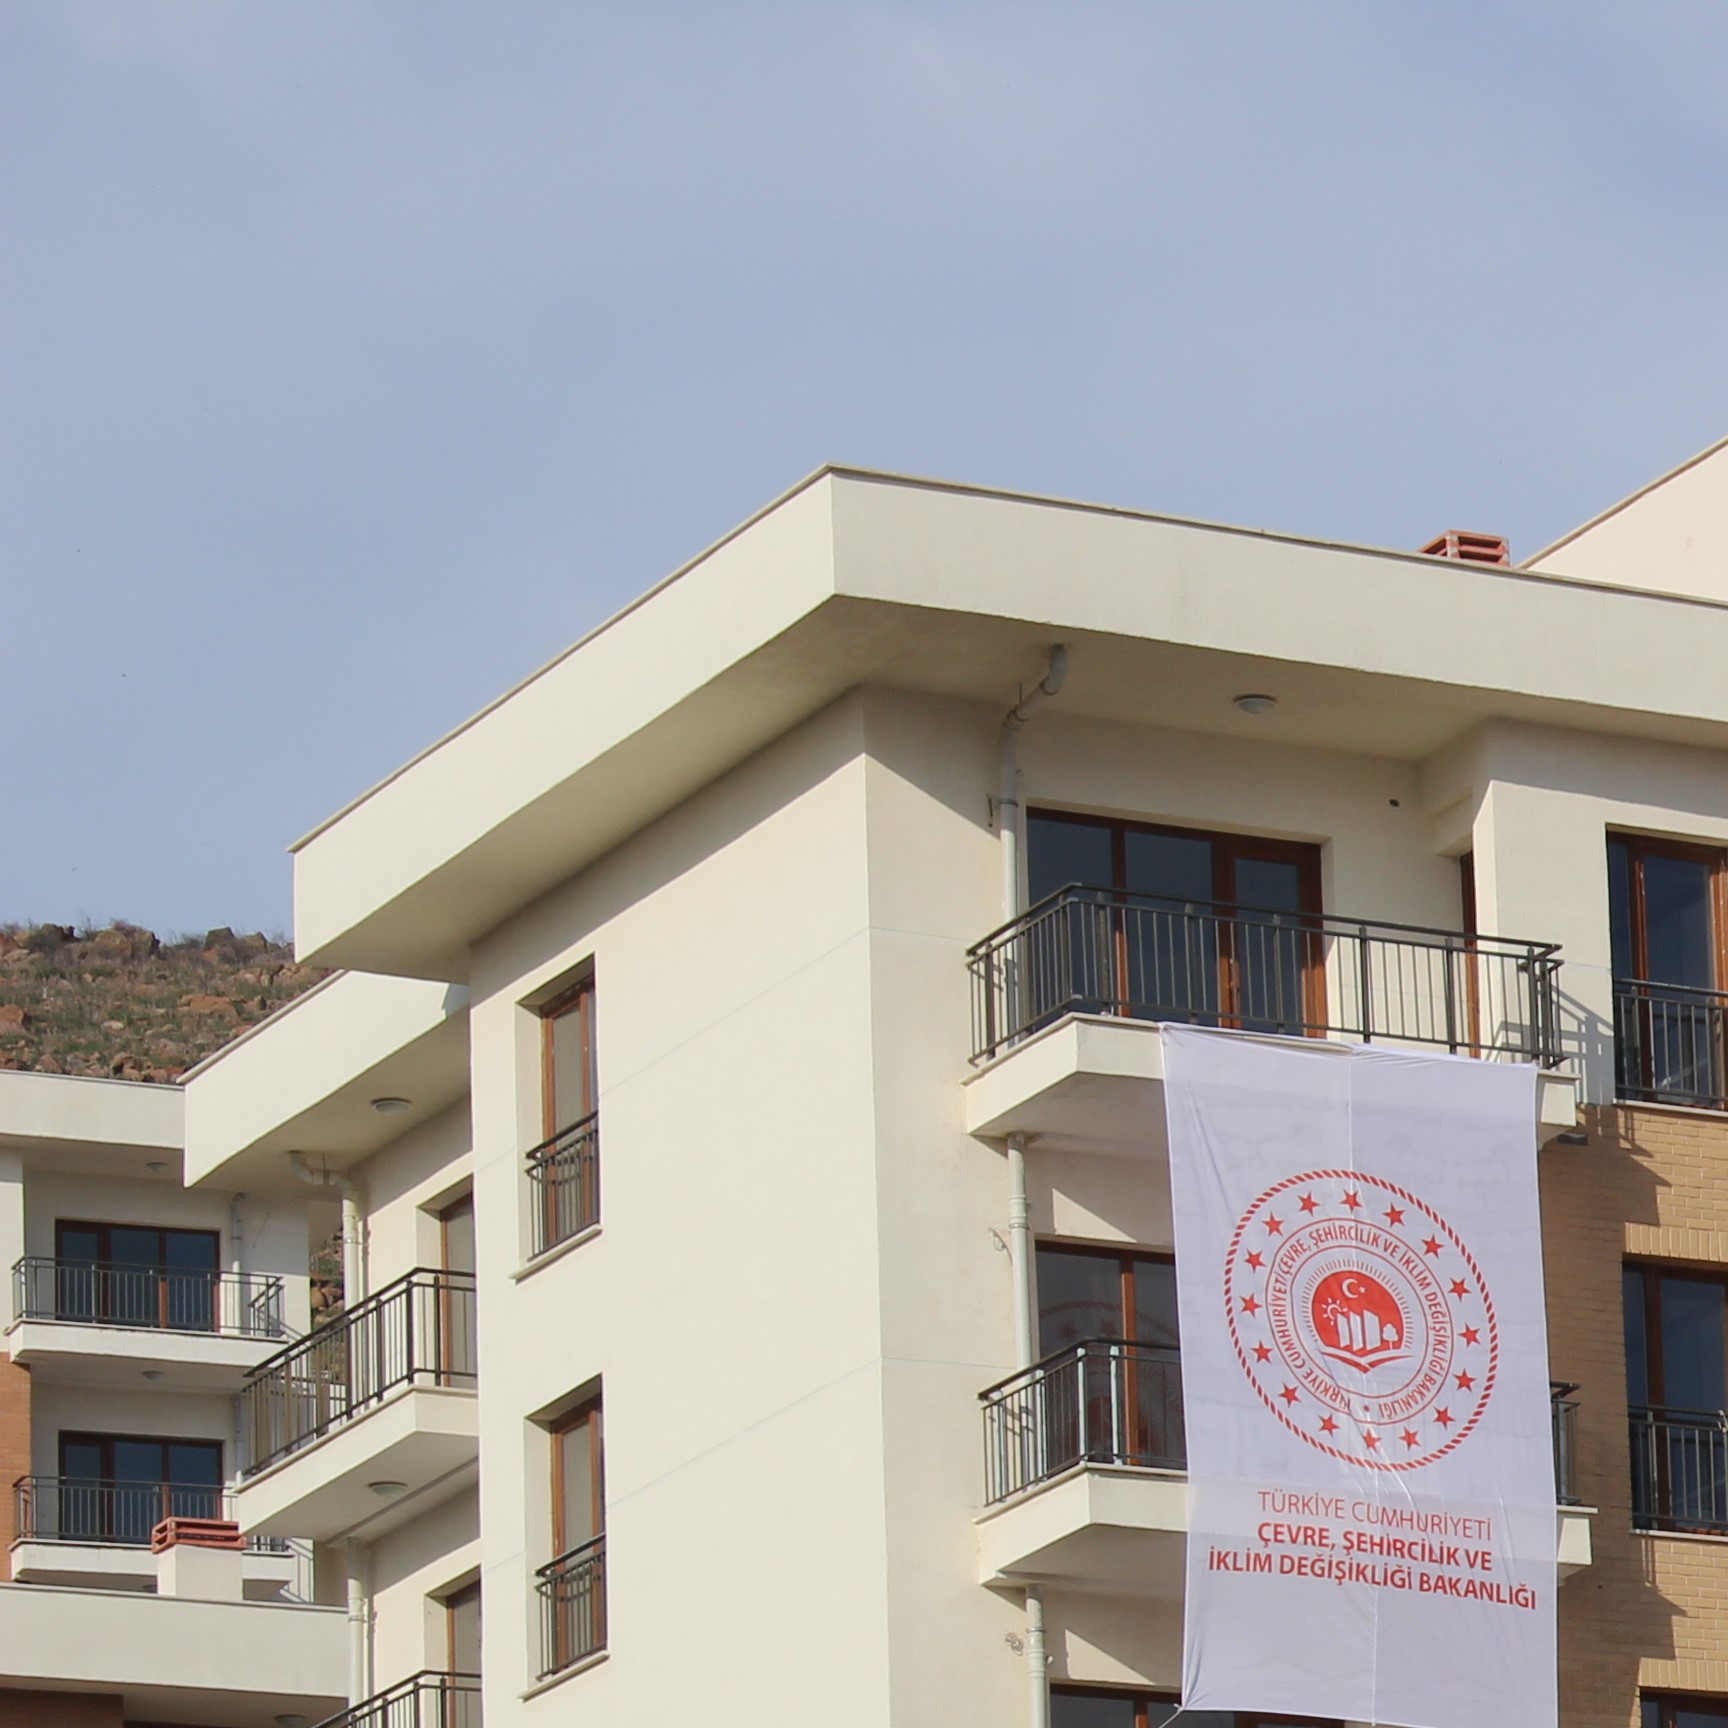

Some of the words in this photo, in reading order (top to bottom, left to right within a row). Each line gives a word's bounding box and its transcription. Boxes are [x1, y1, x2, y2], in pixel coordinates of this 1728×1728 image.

[1278, 1239, 1311, 1276] ÇEVRE,
[1309, 1222, 1381, 1249] ŞEHİRCİLİK
[1383, 1238, 1400, 1258] VE
[1398, 1249, 1432, 1291] İKLİM
[1269, 1271, 1306, 1369] CUMHURİYETİ
[1424, 1291, 1450, 1377] DEĞİŞİKLİĞİ
[1378, 1373, 1437, 1419] BAKANLIĞI
[1257, 1488, 1345, 1519] TÜRKİYE
[1351, 1501, 1491, 1541] CUMHURİYETİ
[1257, 1522, 1336, 1551] ÇEVRE,
[1343, 1530, 1460, 1567] ŞEHİRCİLİK
[1465, 1549, 1493, 1572] VE
[1209, 1545, 1272, 1573] İKLİM
[1279, 1553, 1412, 1590] DEĞİŞİKLİĞİ
[1419, 1572, 1536, 1610] BAKANLIĞI
